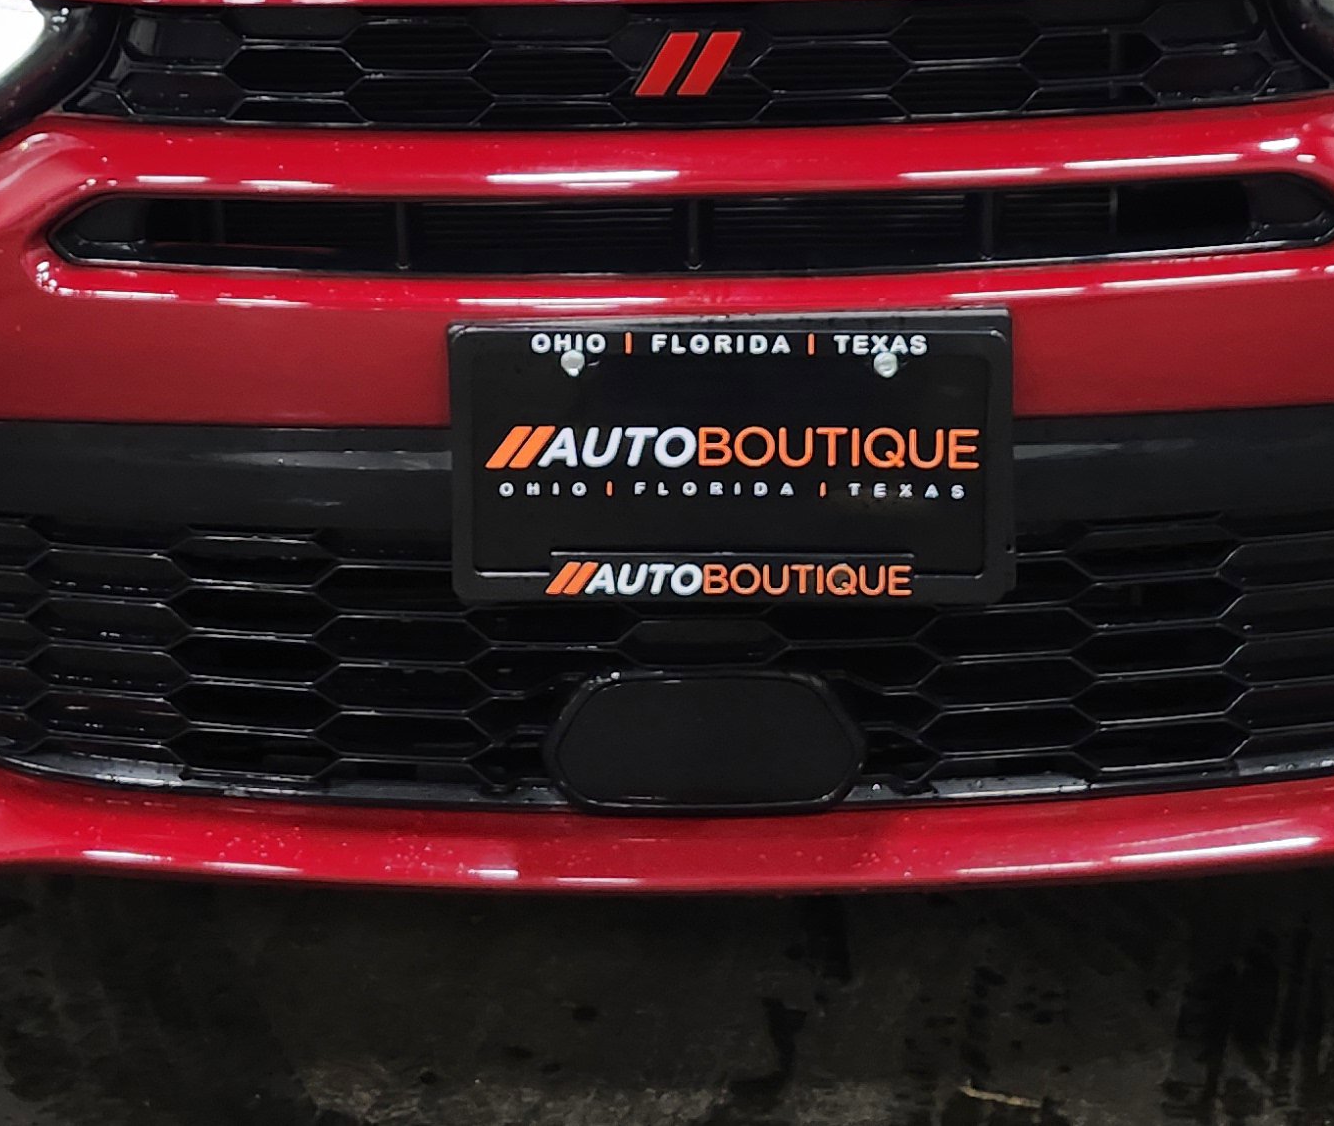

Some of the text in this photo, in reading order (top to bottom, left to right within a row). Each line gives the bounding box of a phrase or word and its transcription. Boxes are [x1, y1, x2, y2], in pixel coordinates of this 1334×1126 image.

[530, 332, 929, 355] OHIO FLORIDA TEXAS
[537, 426, 980, 470] AUTOBOUTIQUE
[498, 481, 966, 500] OHIO FLORIDA TEXAS
[585, 561, 914, 596] AUTOBOUTIQUE
